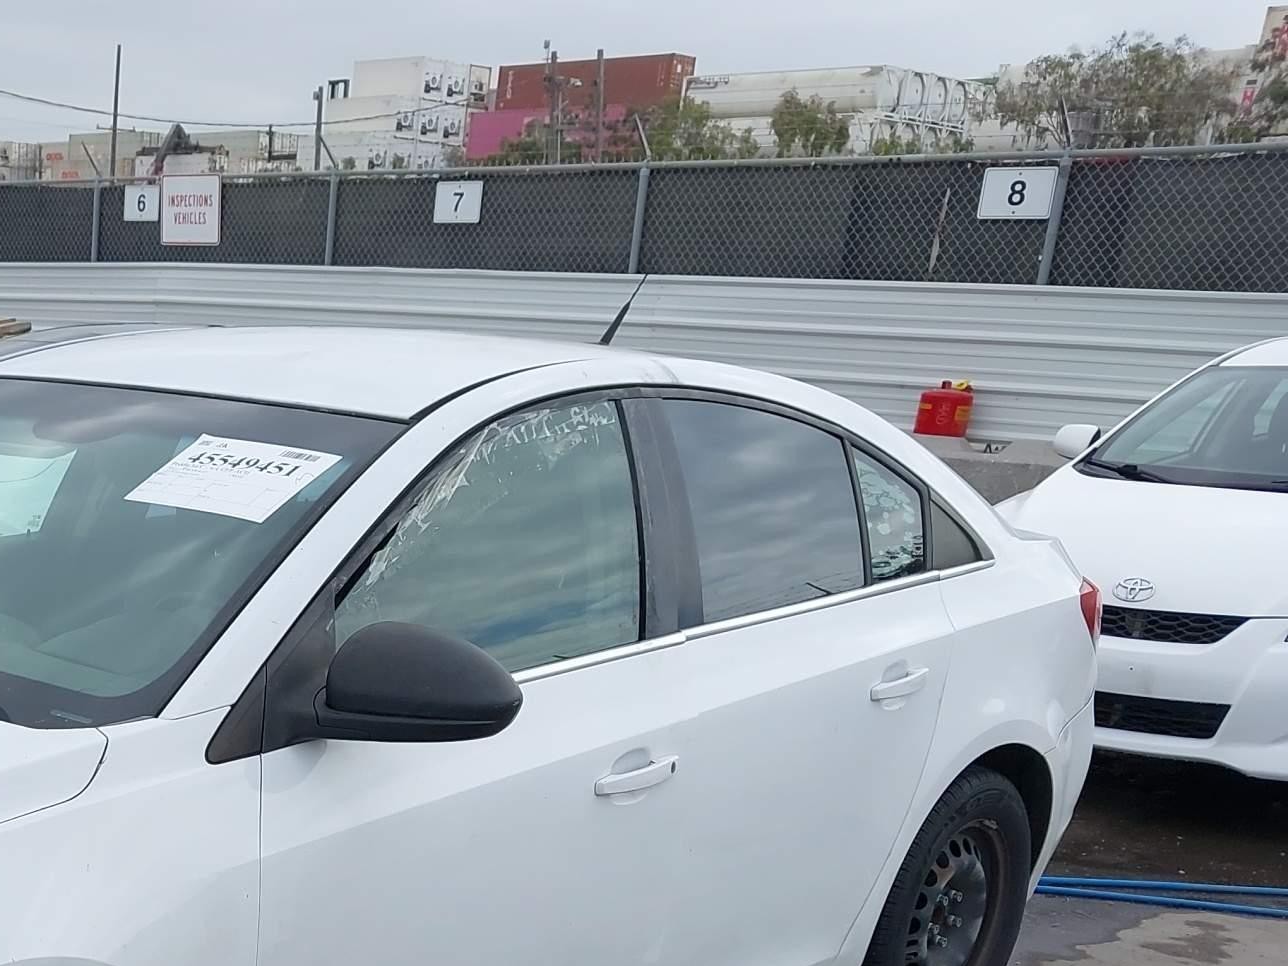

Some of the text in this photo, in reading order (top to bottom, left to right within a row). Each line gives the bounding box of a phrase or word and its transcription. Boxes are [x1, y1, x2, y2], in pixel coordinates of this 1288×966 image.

[168, 194, 213, 207] INSPECTIONS
[453, 192, 464, 212] 7
[1007, 180, 1027, 206] 8
[137, 194, 146, 212] 6
[173, 211, 207, 225] VEHICLES
[188, 451, 301, 477] 45549451
